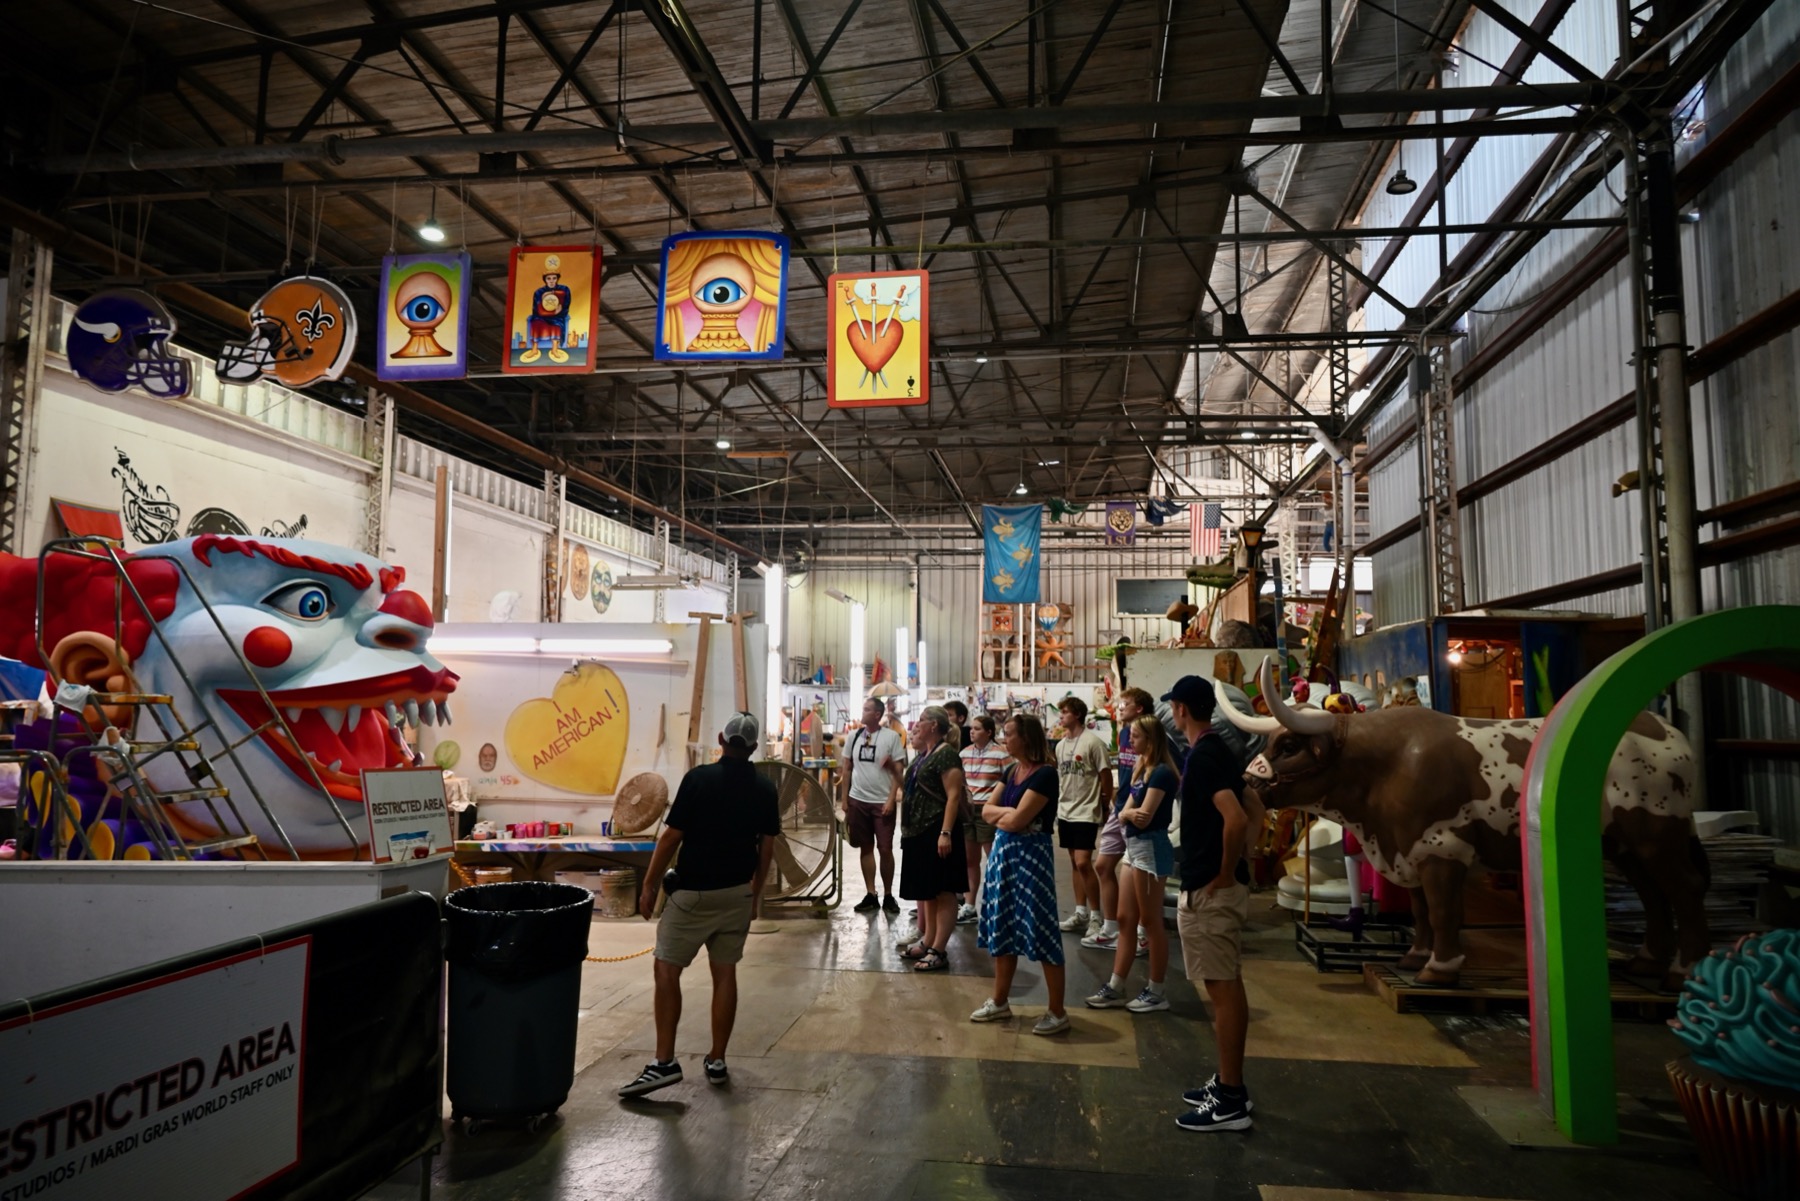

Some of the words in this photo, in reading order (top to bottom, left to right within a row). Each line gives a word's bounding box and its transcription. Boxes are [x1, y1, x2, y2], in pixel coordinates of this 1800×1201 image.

[1107, 535, 1134, 545] LSU
[552, 700, 562, 713] I
[556, 706, 582, 734] AM
[372, 800, 421, 816] RESTRICTED
[424, 798, 445, 811] AREA
[210, 1021, 296, 1089] AREA
[1, 1161, 76, 1201] STUDIOS
[90, 1134, 139, 1169] MARDI
[142, 1115, 179, 1144] GRAS
[182, 1094, 228, 1127] WORLD
[230, 1078, 264, 1105] STAFF
[265, 1063, 295, 1088] ONLY
